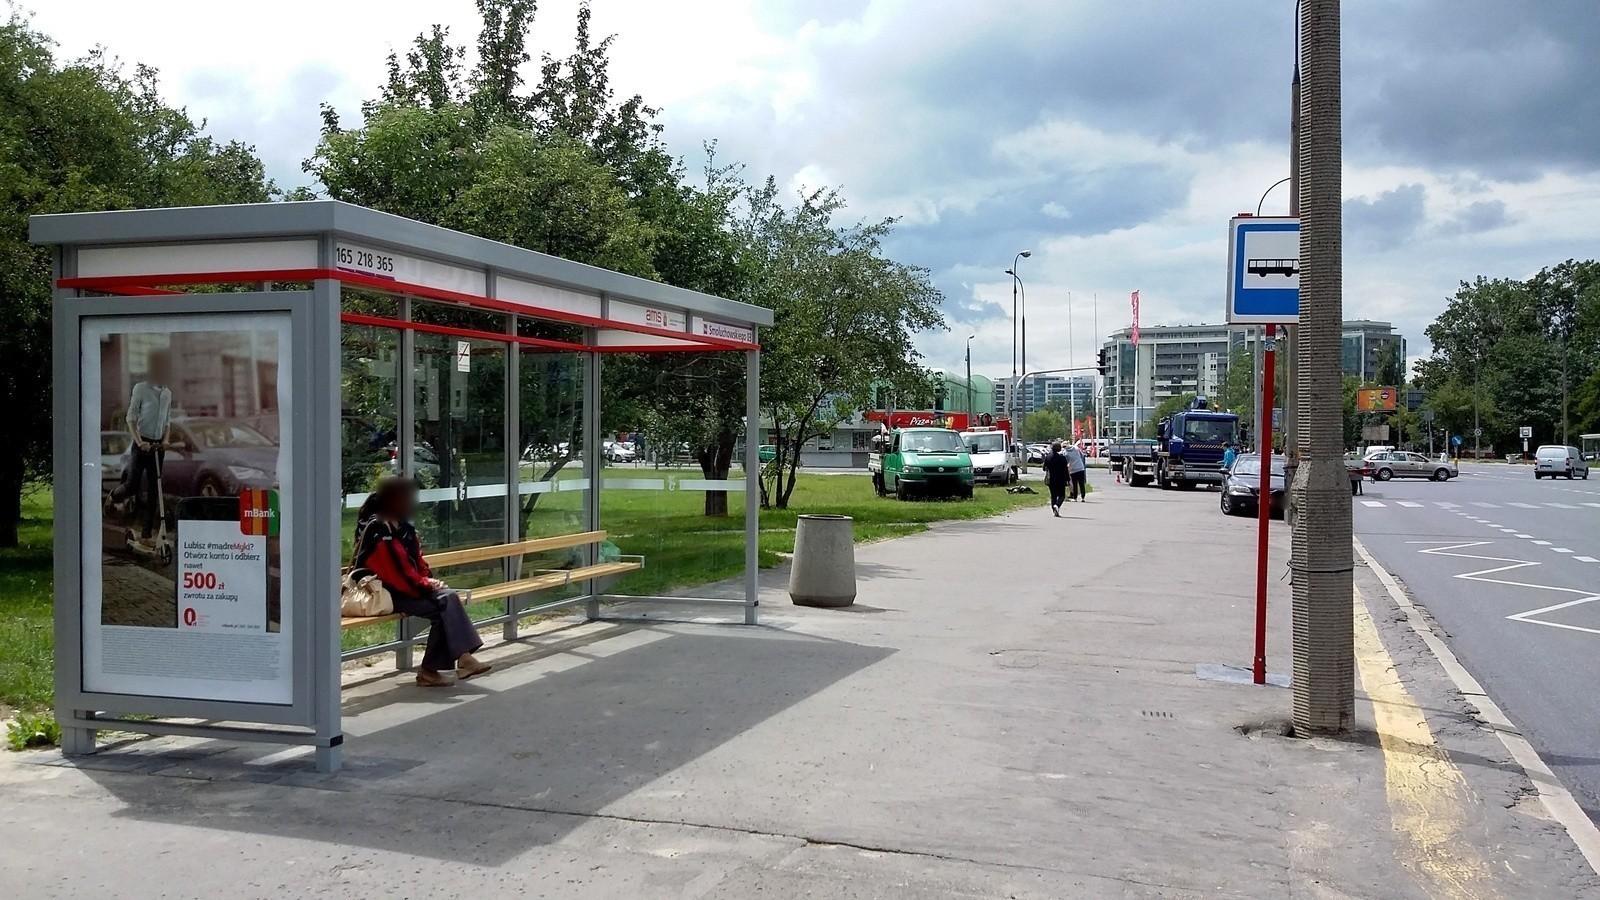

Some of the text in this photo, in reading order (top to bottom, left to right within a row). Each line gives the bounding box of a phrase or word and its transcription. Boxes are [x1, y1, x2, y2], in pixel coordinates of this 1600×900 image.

[337, 247, 393, 272] 165 218 365
[646, 309, 662, 323] ams
[244, 508, 275, 518] mBank
[184, 541, 206, 550] Lubisz
[209, 552, 230, 560] konto
[235, 553, 260, 561] odbierz
[183, 572, 216, 589] 500
[215, 593, 239, 602] zakupy
